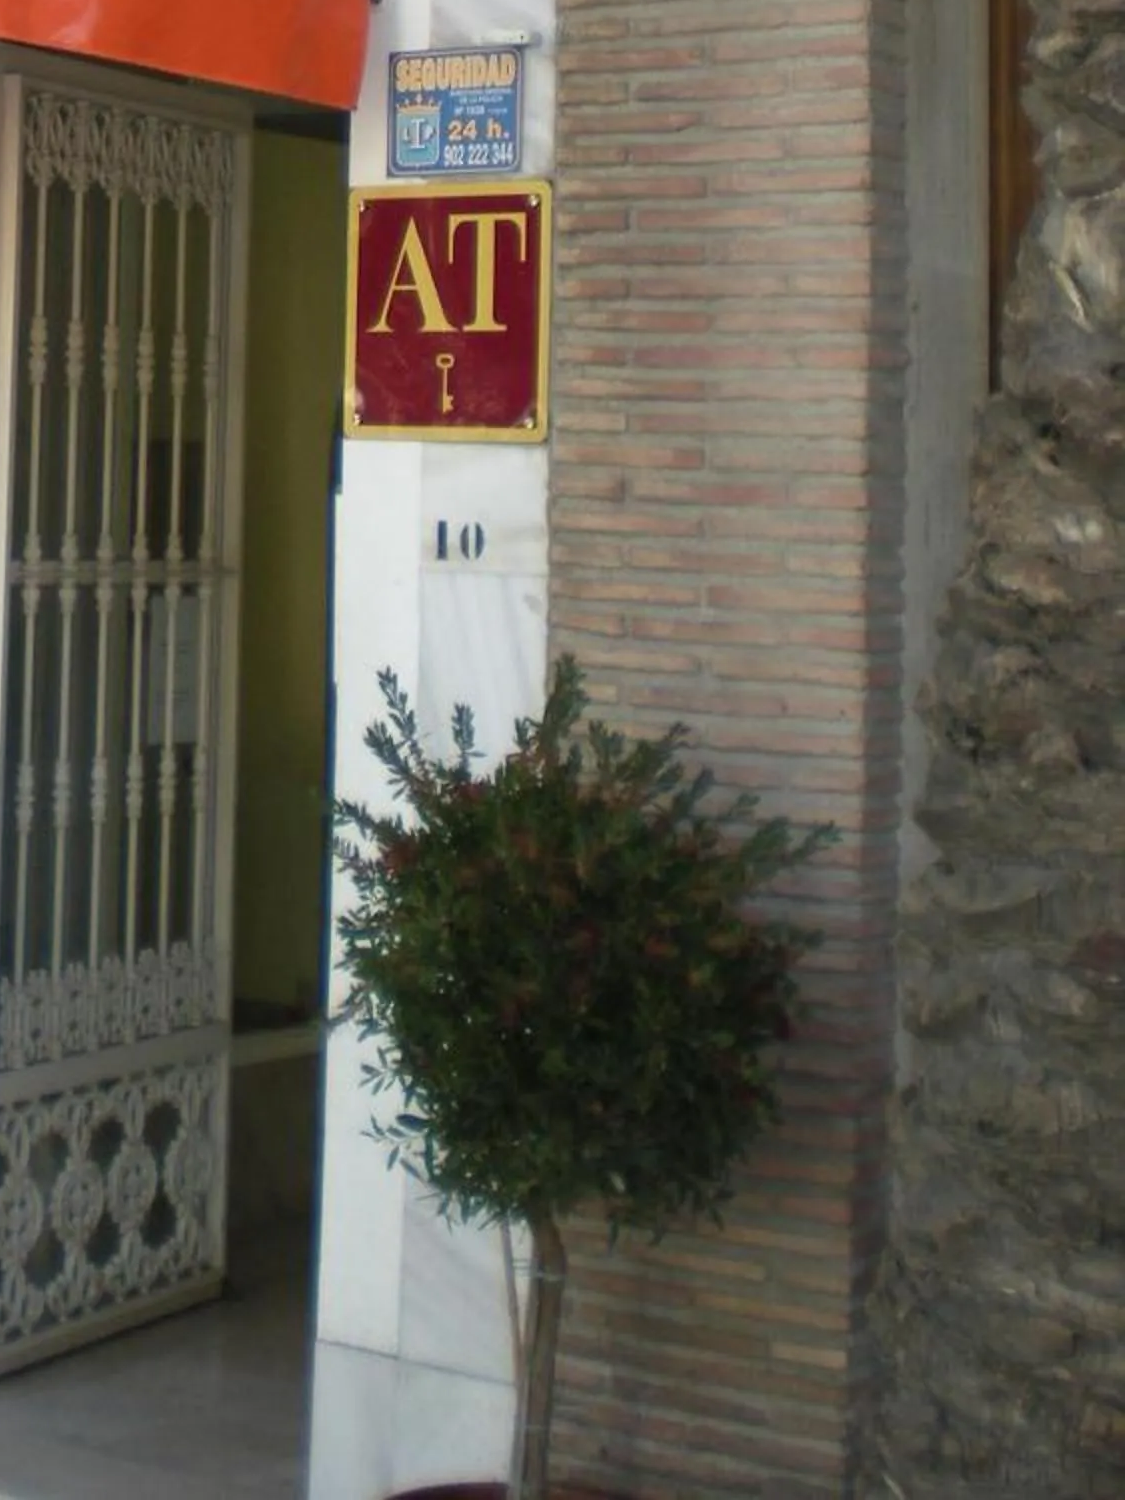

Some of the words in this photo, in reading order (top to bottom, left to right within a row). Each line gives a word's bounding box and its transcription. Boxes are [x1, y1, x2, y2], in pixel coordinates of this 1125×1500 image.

[396, 52, 516, 92] SEGURIDAD
[448, 119, 478, 141] 24
[443, 143, 465, 167] 902
[467, 142, 490, 165] 222
[366, 212, 527, 334] AT
[435, 520, 485, 562] 10
